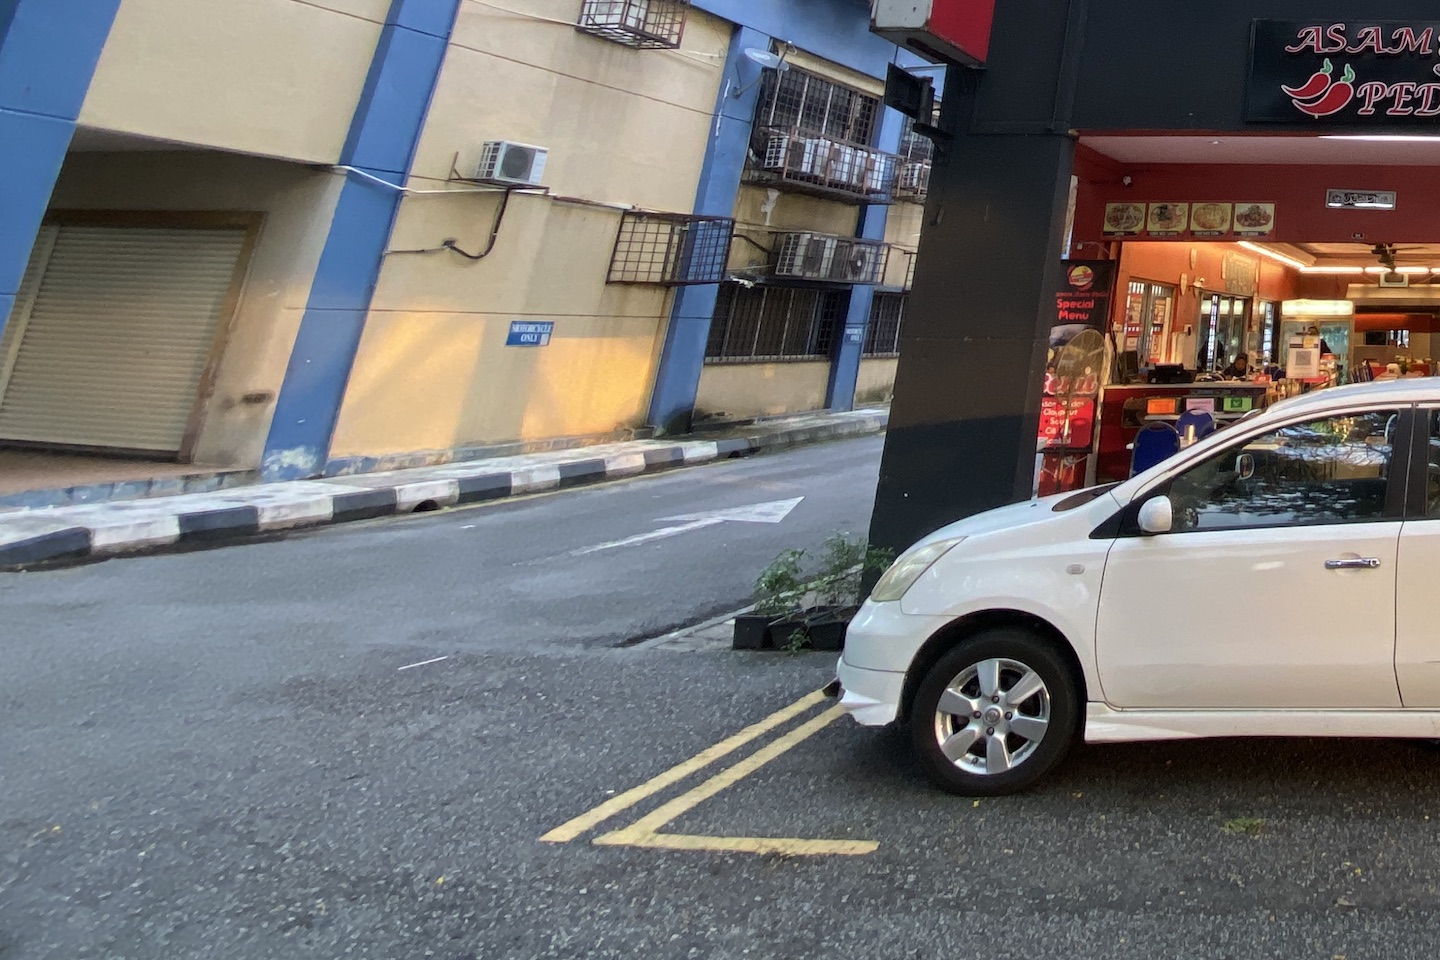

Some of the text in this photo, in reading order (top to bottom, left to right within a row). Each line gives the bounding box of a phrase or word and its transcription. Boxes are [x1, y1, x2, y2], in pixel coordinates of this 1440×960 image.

[1284, 23, 1434, 55] ASAM
[1056, 298, 1095, 310] Special
[1058, 310, 1089, 321] Menu
[520, 333, 538, 343] ONLY
